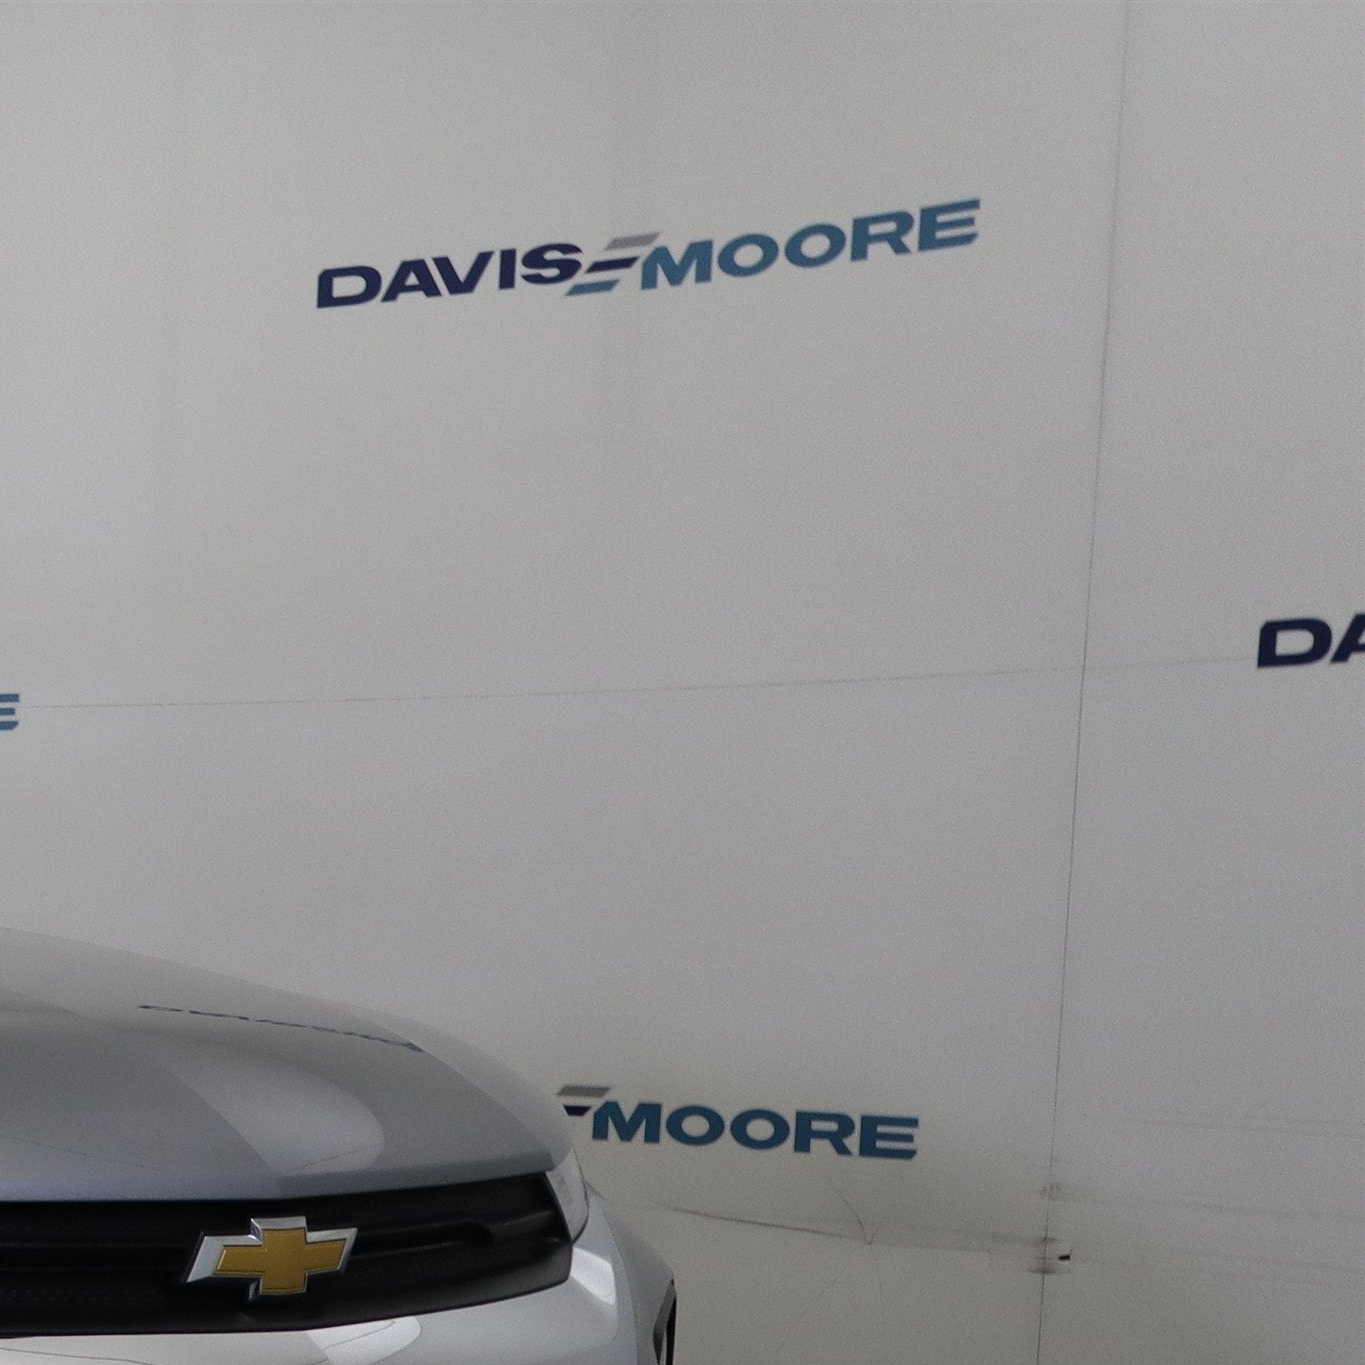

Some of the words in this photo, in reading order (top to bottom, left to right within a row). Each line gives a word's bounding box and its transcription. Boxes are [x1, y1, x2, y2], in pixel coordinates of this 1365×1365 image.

[316, 243, 582, 308] DAVIS
[641, 199, 980, 290] MOORE
[592, 1101, 919, 1160] MOORE
